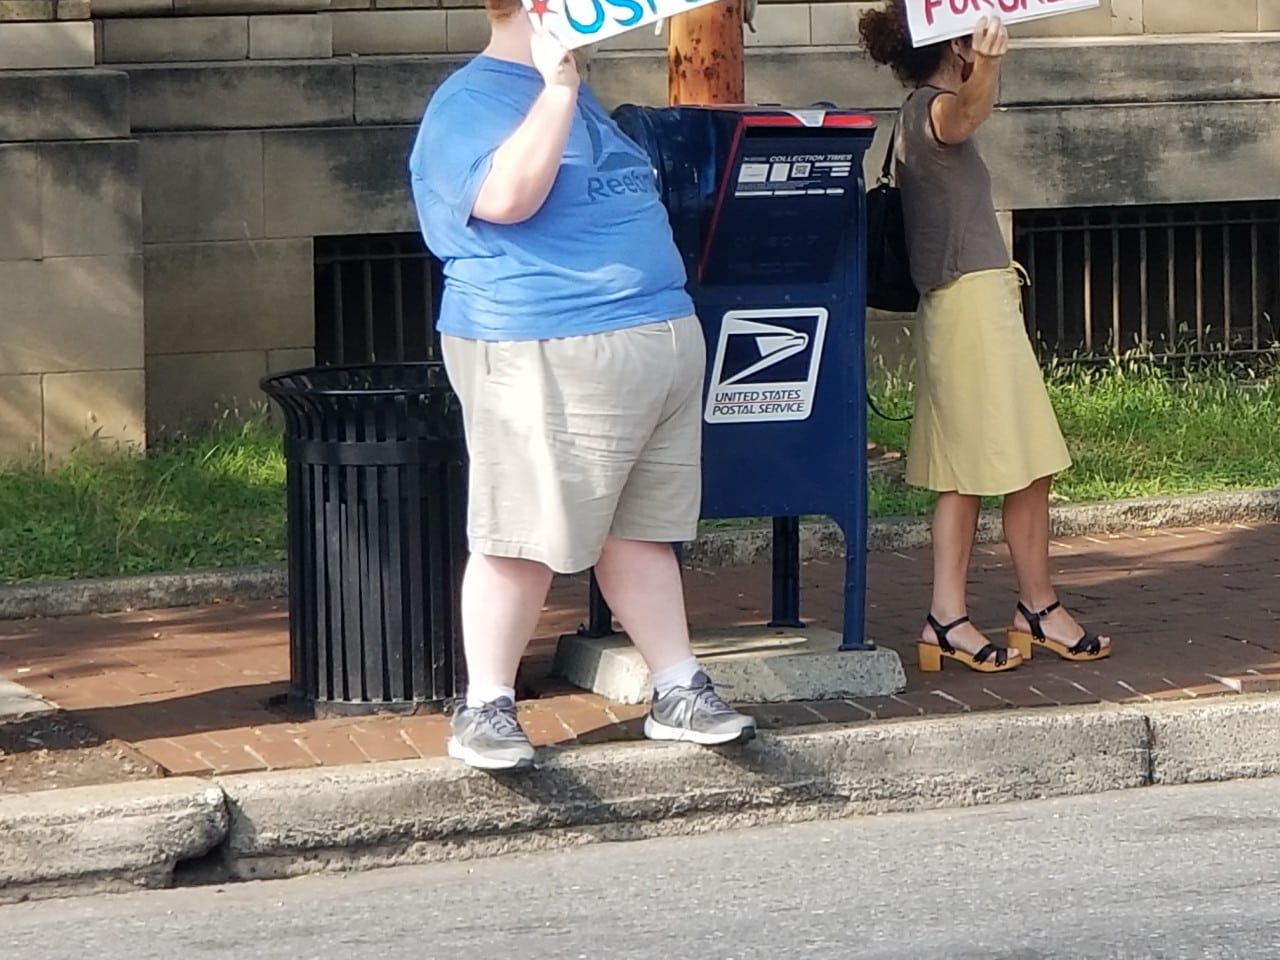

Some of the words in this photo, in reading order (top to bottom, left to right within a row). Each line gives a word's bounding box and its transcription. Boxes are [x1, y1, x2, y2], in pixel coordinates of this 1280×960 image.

[715, 391, 760, 403] UNITED
[761, 389, 802, 401] STATES
[712, 404, 756, 416] POSTAL
[757, 402, 805, 414] SERVICE
